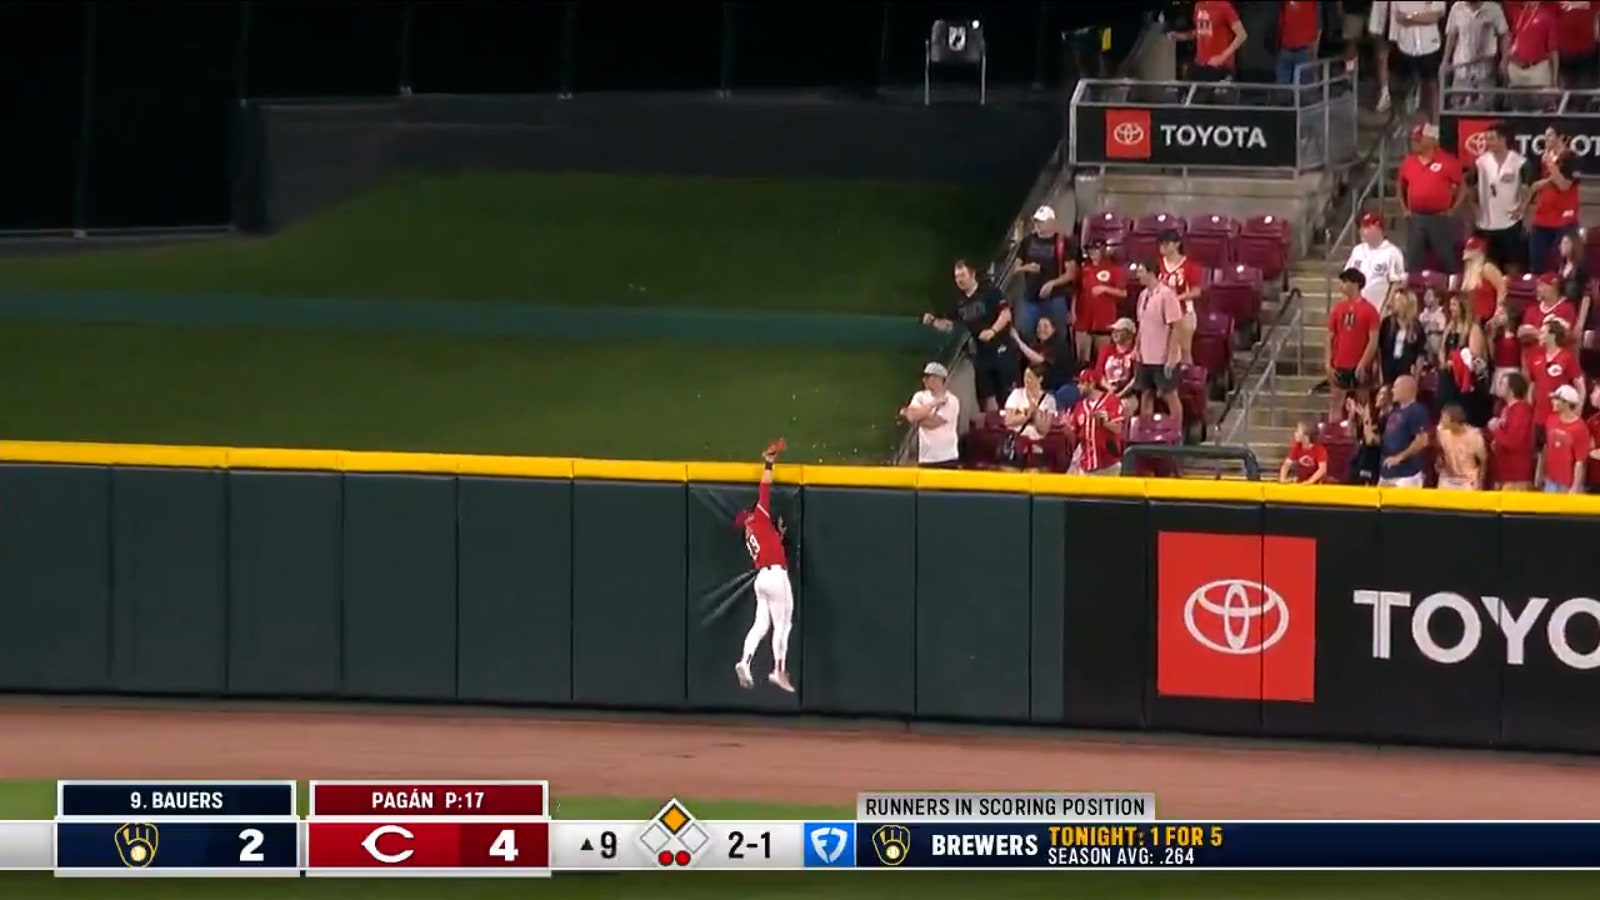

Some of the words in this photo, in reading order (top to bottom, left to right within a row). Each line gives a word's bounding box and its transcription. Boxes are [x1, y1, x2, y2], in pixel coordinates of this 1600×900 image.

[1160, 125, 1267, 148] TOYOTA
[1514, 134, 1600, 156] TOOT
[1353, 589, 1600, 670] TOYO
